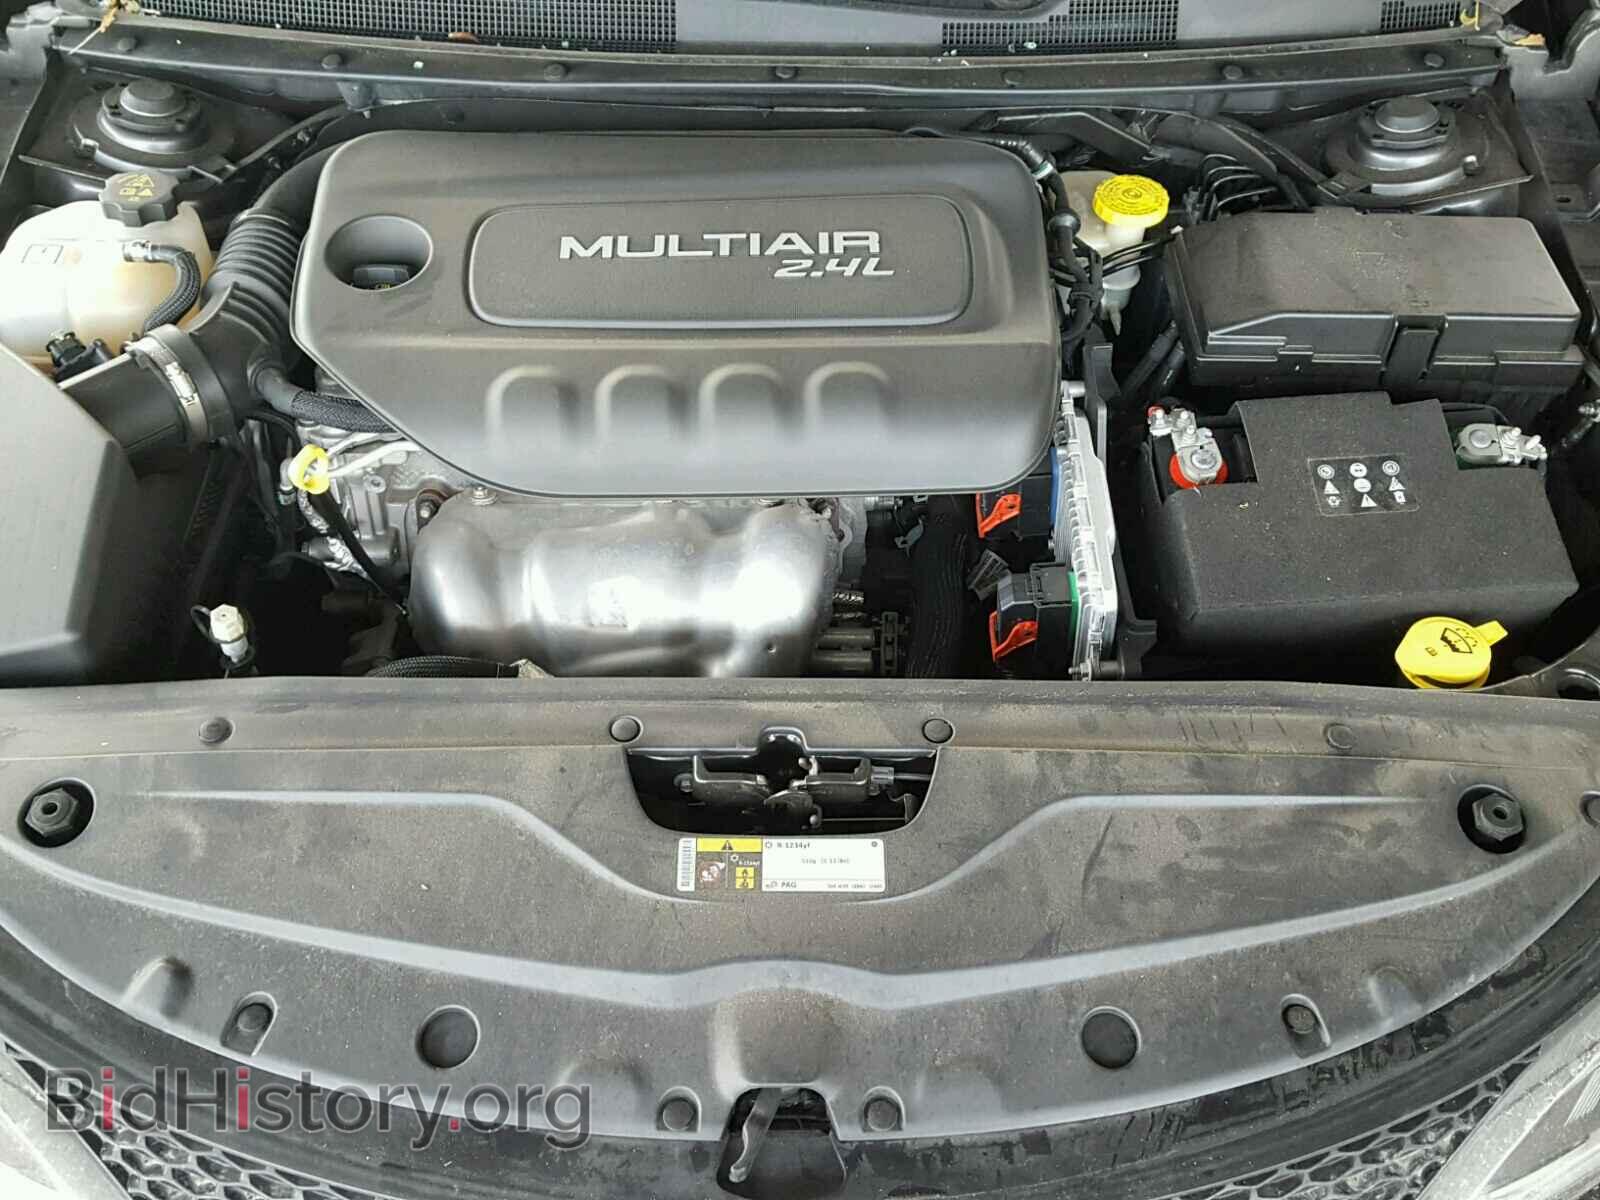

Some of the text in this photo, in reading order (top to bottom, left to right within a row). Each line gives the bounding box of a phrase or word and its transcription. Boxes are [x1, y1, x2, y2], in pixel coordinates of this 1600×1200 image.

[560, 231, 881, 259] MULTIAIR
[774, 258, 895, 278] 2.4L
[781, 880, 797, 888] PAG
